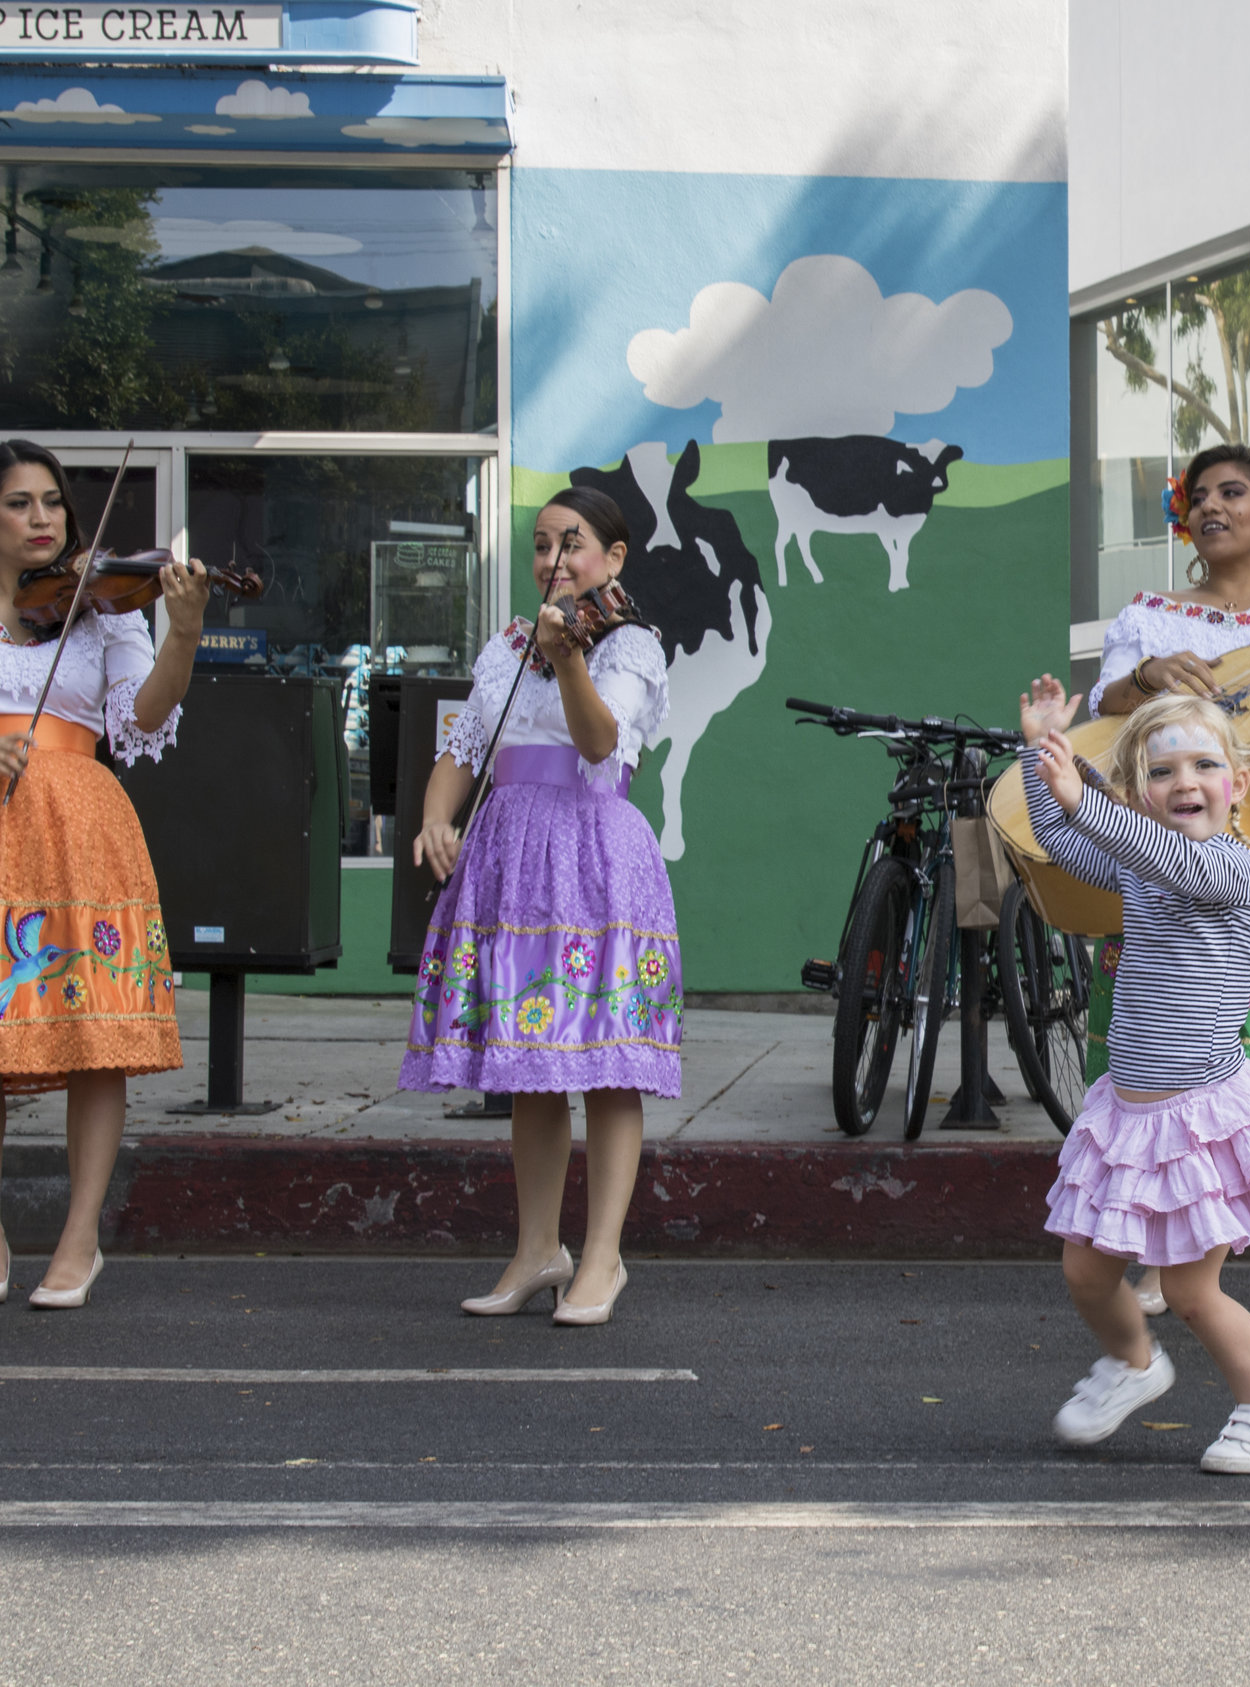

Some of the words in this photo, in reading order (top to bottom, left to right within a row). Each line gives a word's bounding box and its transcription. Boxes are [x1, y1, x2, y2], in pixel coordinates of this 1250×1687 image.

[18, 8, 83, 40] ICE
[101, 8, 248, 41] CREAM
[426, 557, 457, 568] CAKES
[201, 634, 258, 650] JERRY'S
